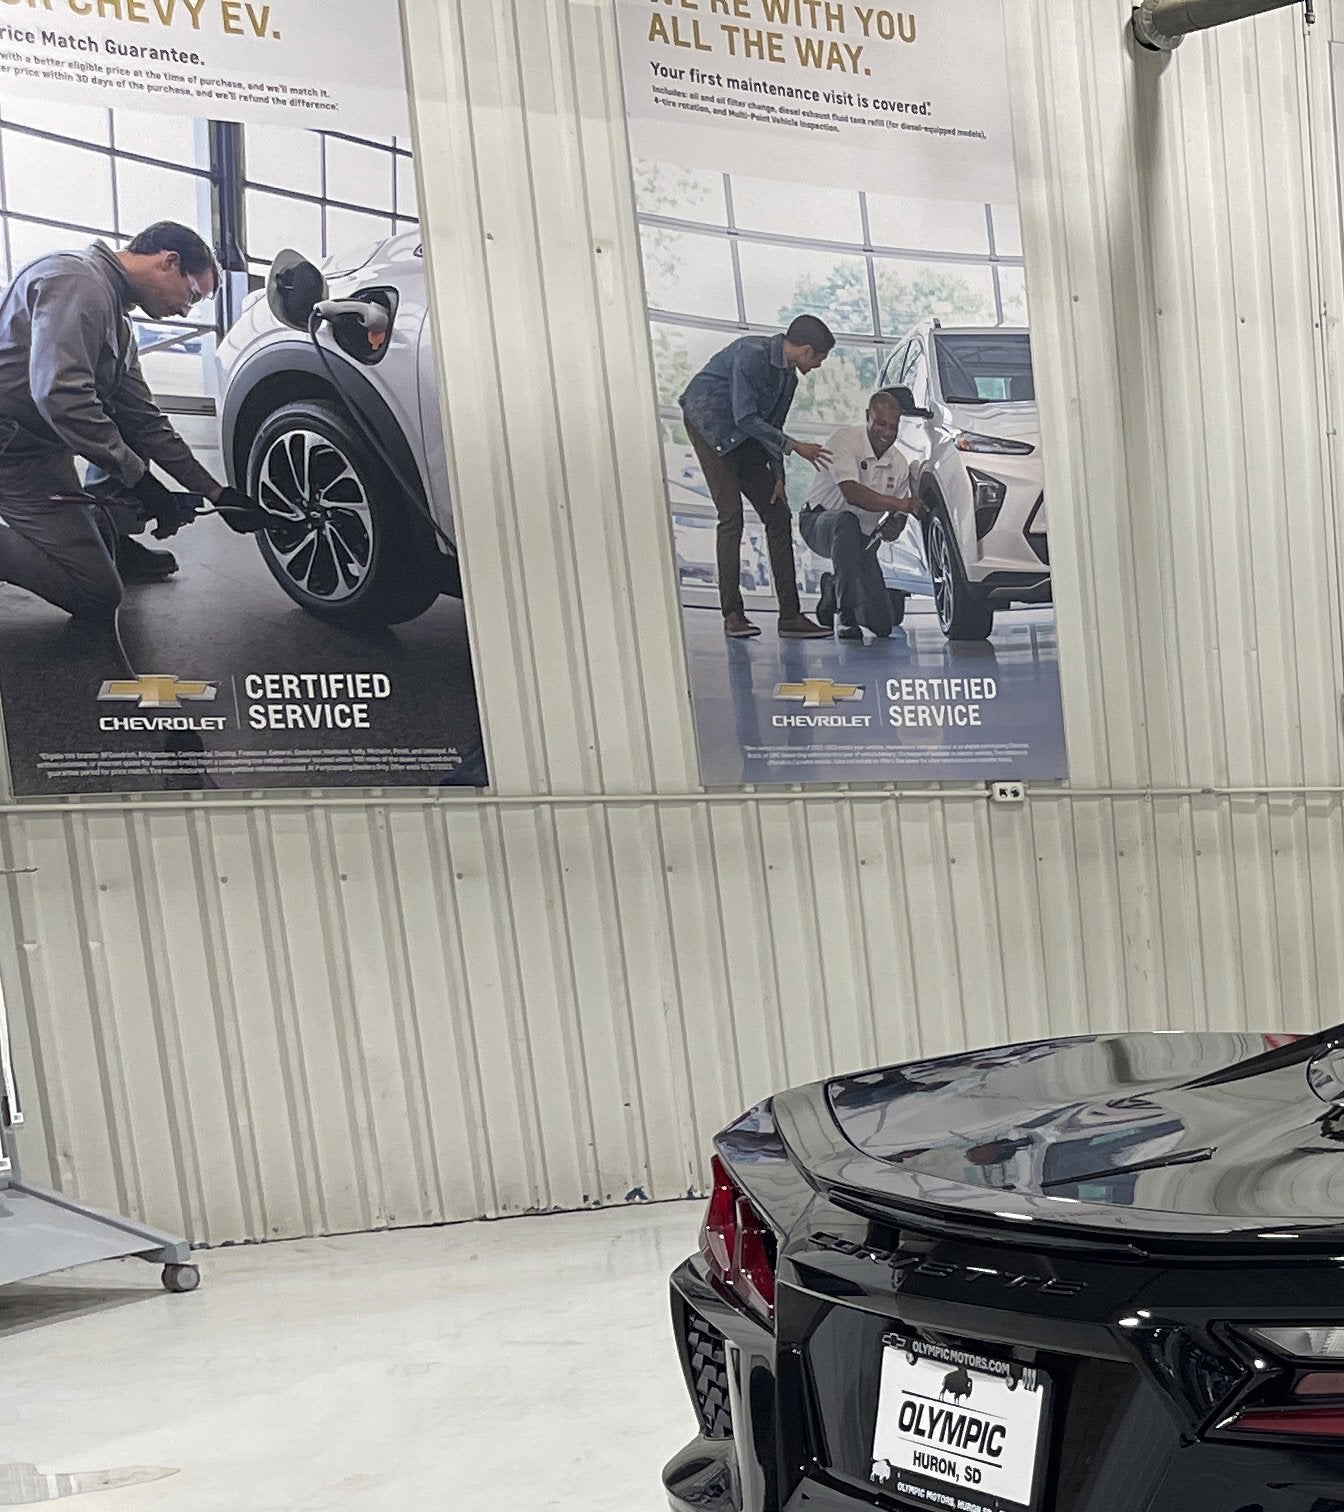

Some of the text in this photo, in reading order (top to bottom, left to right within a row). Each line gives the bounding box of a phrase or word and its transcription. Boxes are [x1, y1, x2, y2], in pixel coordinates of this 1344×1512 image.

[221, 0, 281, 39] EV.
[762, 0, 846, 34] WITH
[855, 6, 917, 44] YOU
[41, 30, 99, 53] Match
[105, 39, 205, 66] Guarantee.
[649, 12, 872, 77] ALL THE WAY.
[650, 60, 686, 82] Your
[689, 68, 723, 88] first
[727, 78, 820, 102] maintenance
[823, 90, 854, 107] visit
[857, 93, 869, 109] is
[244, 673, 391, 701] CERTIFIED
[885, 677, 998, 701] CERTIFIED
[99, 715, 227, 732] CHEVROLET
[248, 703, 370, 730] SERVICE
[771, 715, 872, 728] CHEVROLET
[888, 704, 982, 727] SERVICE
[808, 1232, 1088, 1295] CORVETTE
[898, 1400, 1007, 1458] OLYMPIC
[912, 1450, 982, 1485] HURON, SD
[896, 1481, 926, 1499] OLYMPIC
